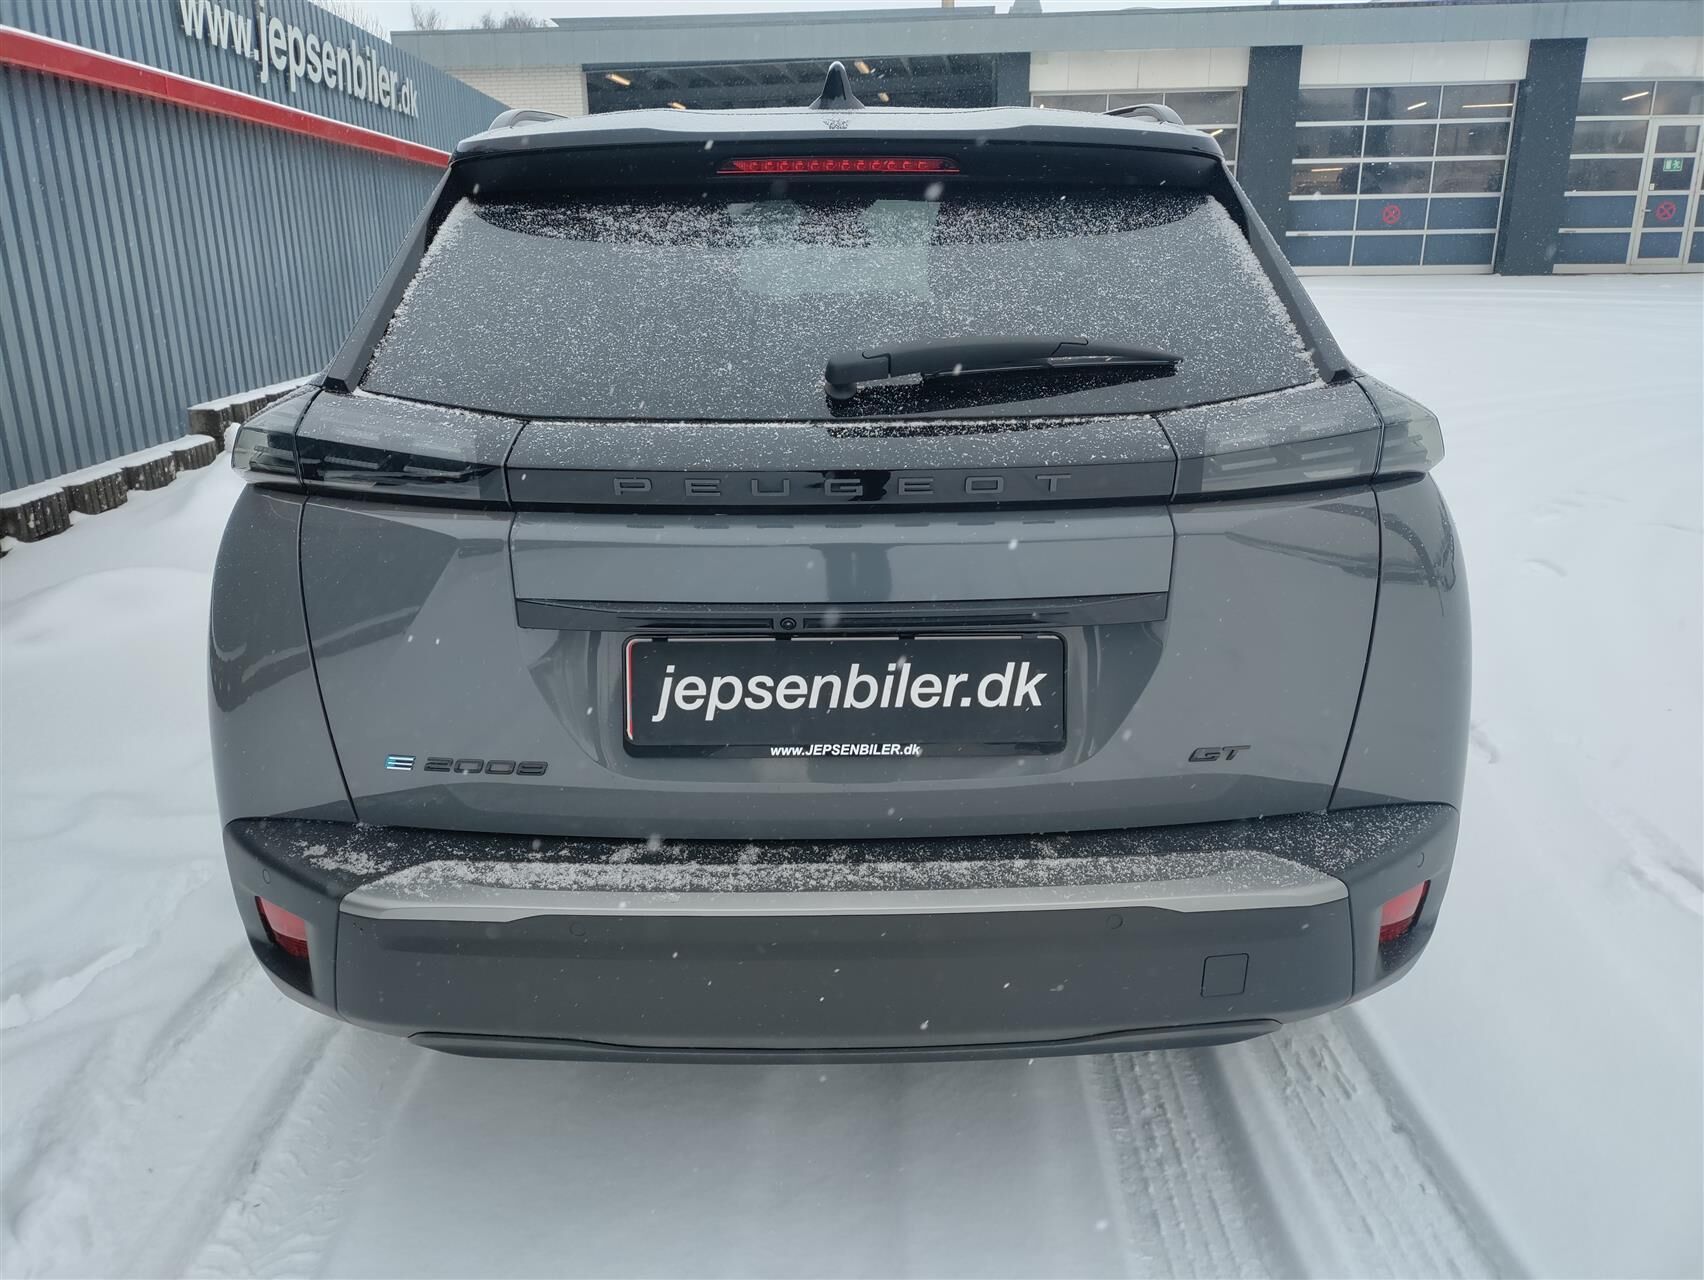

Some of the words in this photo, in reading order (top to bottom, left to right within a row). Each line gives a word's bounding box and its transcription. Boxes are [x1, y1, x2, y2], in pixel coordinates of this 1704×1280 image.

[180, 0, 418, 118] www.jepsenbiler.dk
[613, 474, 1071, 497] PEUGEOT
[652, 662, 1048, 722] jepsenbiler.dk
[770, 744, 921, 756] www.JEPSENBILER.dk
[1188, 745, 1251, 762] GT
